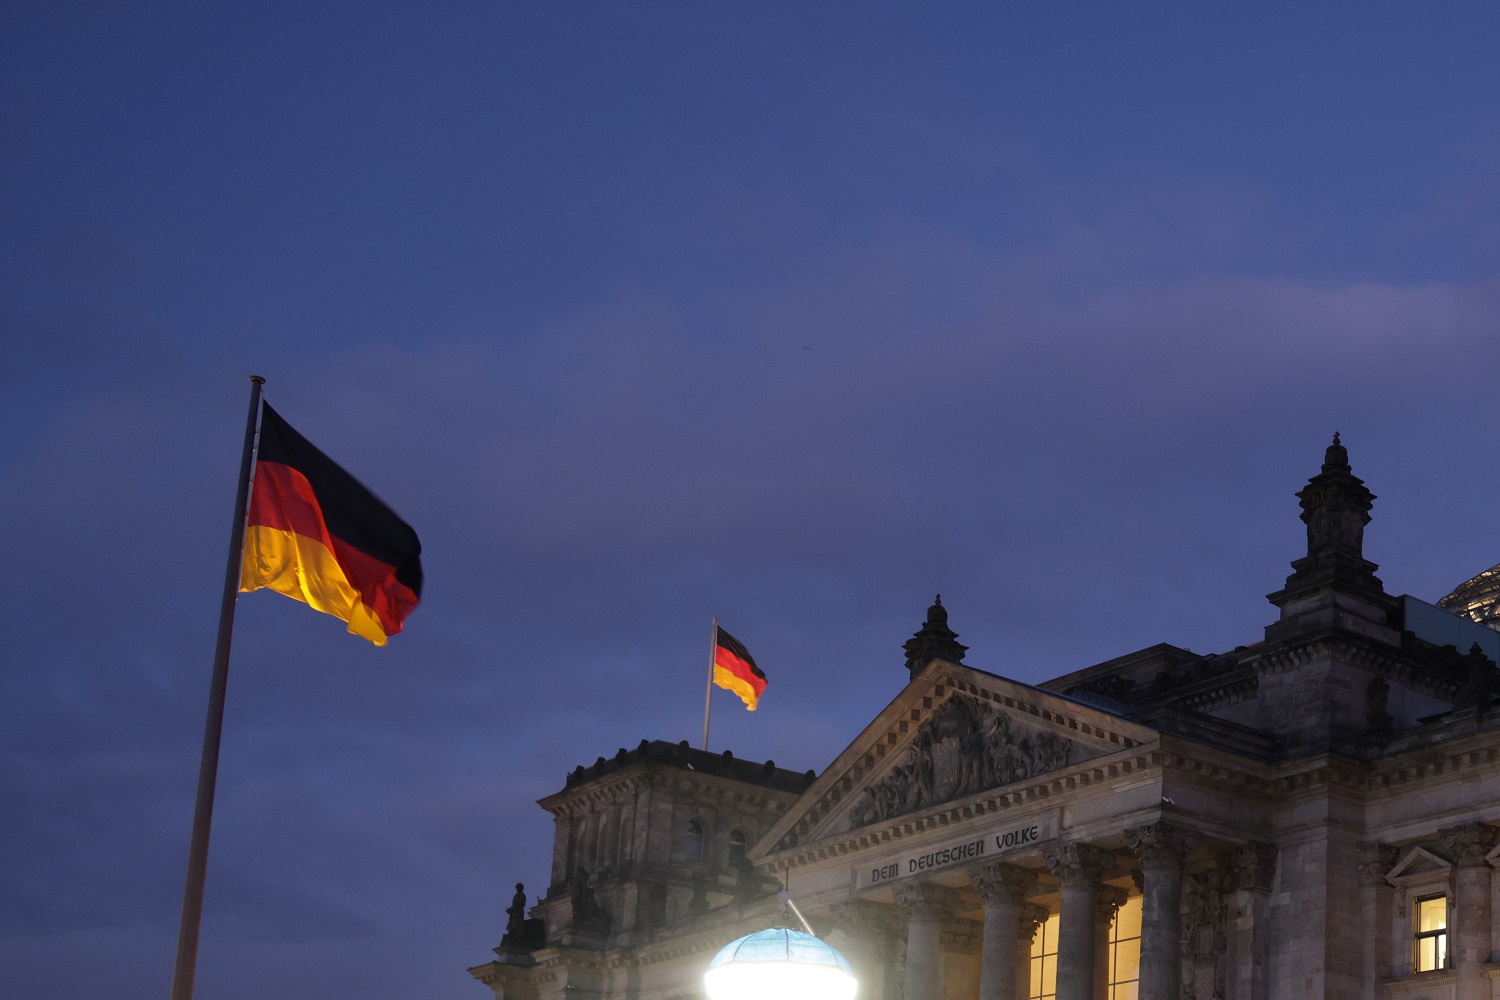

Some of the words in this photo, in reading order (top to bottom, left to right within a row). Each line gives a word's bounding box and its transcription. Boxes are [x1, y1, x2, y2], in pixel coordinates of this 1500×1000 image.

[871, 863, 899, 883] DEM
[909, 840, 984, 873] DEUTSCHEN
[996, 825, 1039, 849] VOLKE
